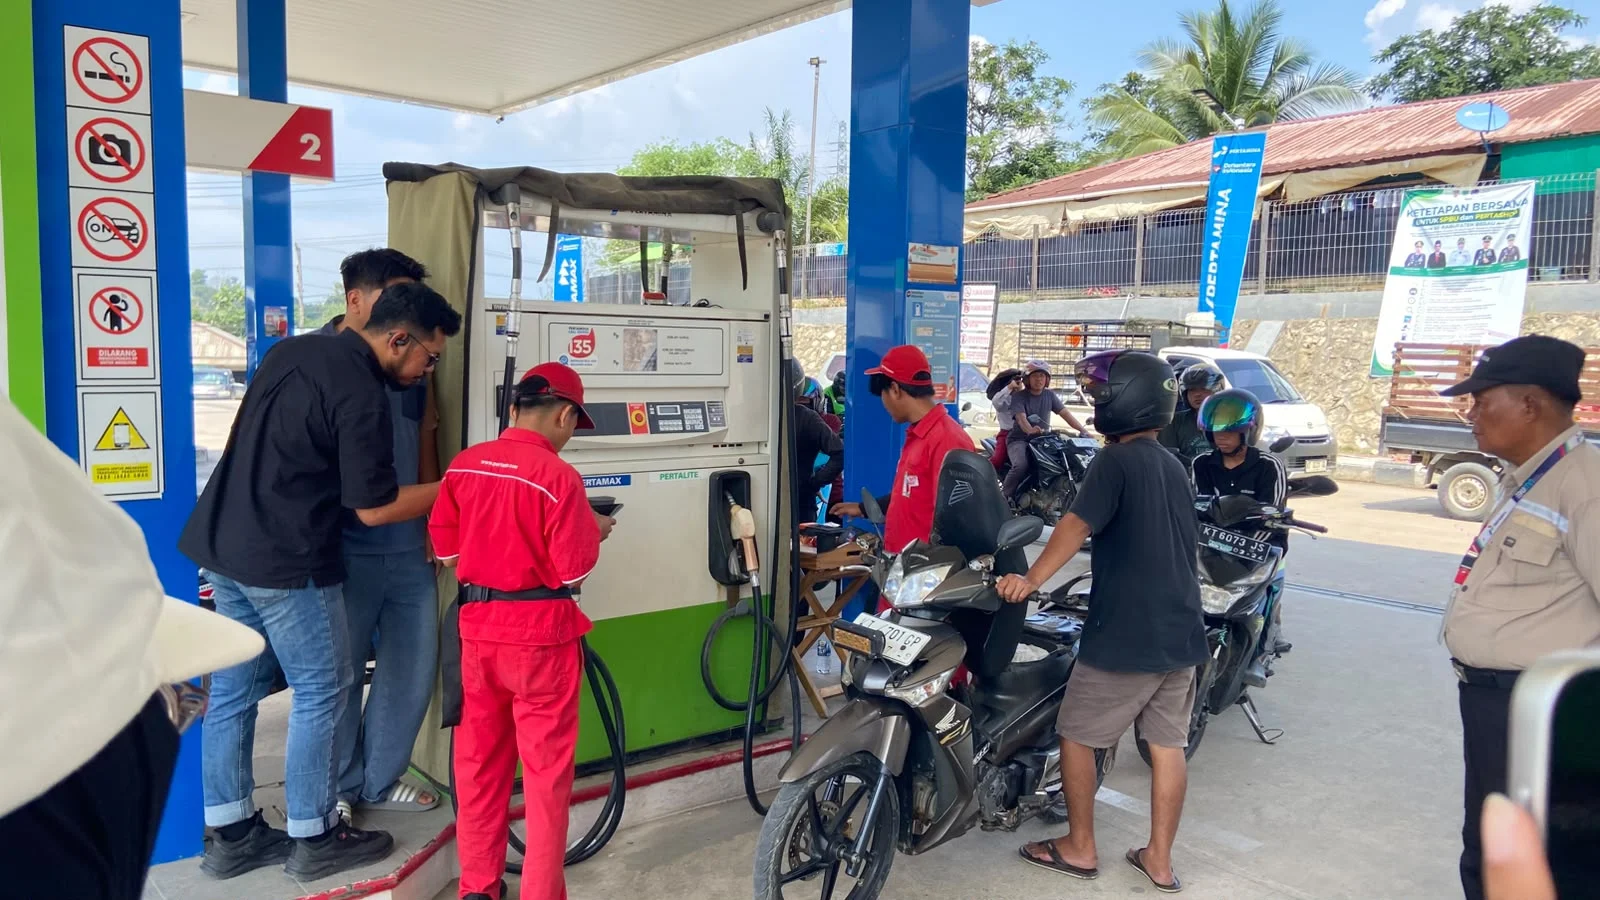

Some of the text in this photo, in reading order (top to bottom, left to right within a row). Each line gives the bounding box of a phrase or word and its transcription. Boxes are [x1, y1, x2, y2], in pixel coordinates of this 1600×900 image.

[300, 133, 322, 162] 2
[1406, 203, 1470, 218] KETETAPAN
[1415, 217, 1440, 226] UNTUK
[1439, 215, 1460, 223] SPBU
[1460, 213, 1474, 221] dan
[98, 349, 138, 358] DILARANG
[569, 339, 593, 355] 135
[582, 477, 622, 487] ERTAMAX
[659, 471, 699, 481] PERTALITE
[1203, 526, 1265, 553] KT 6073 JS
[879, 623, 906, 642] 701
